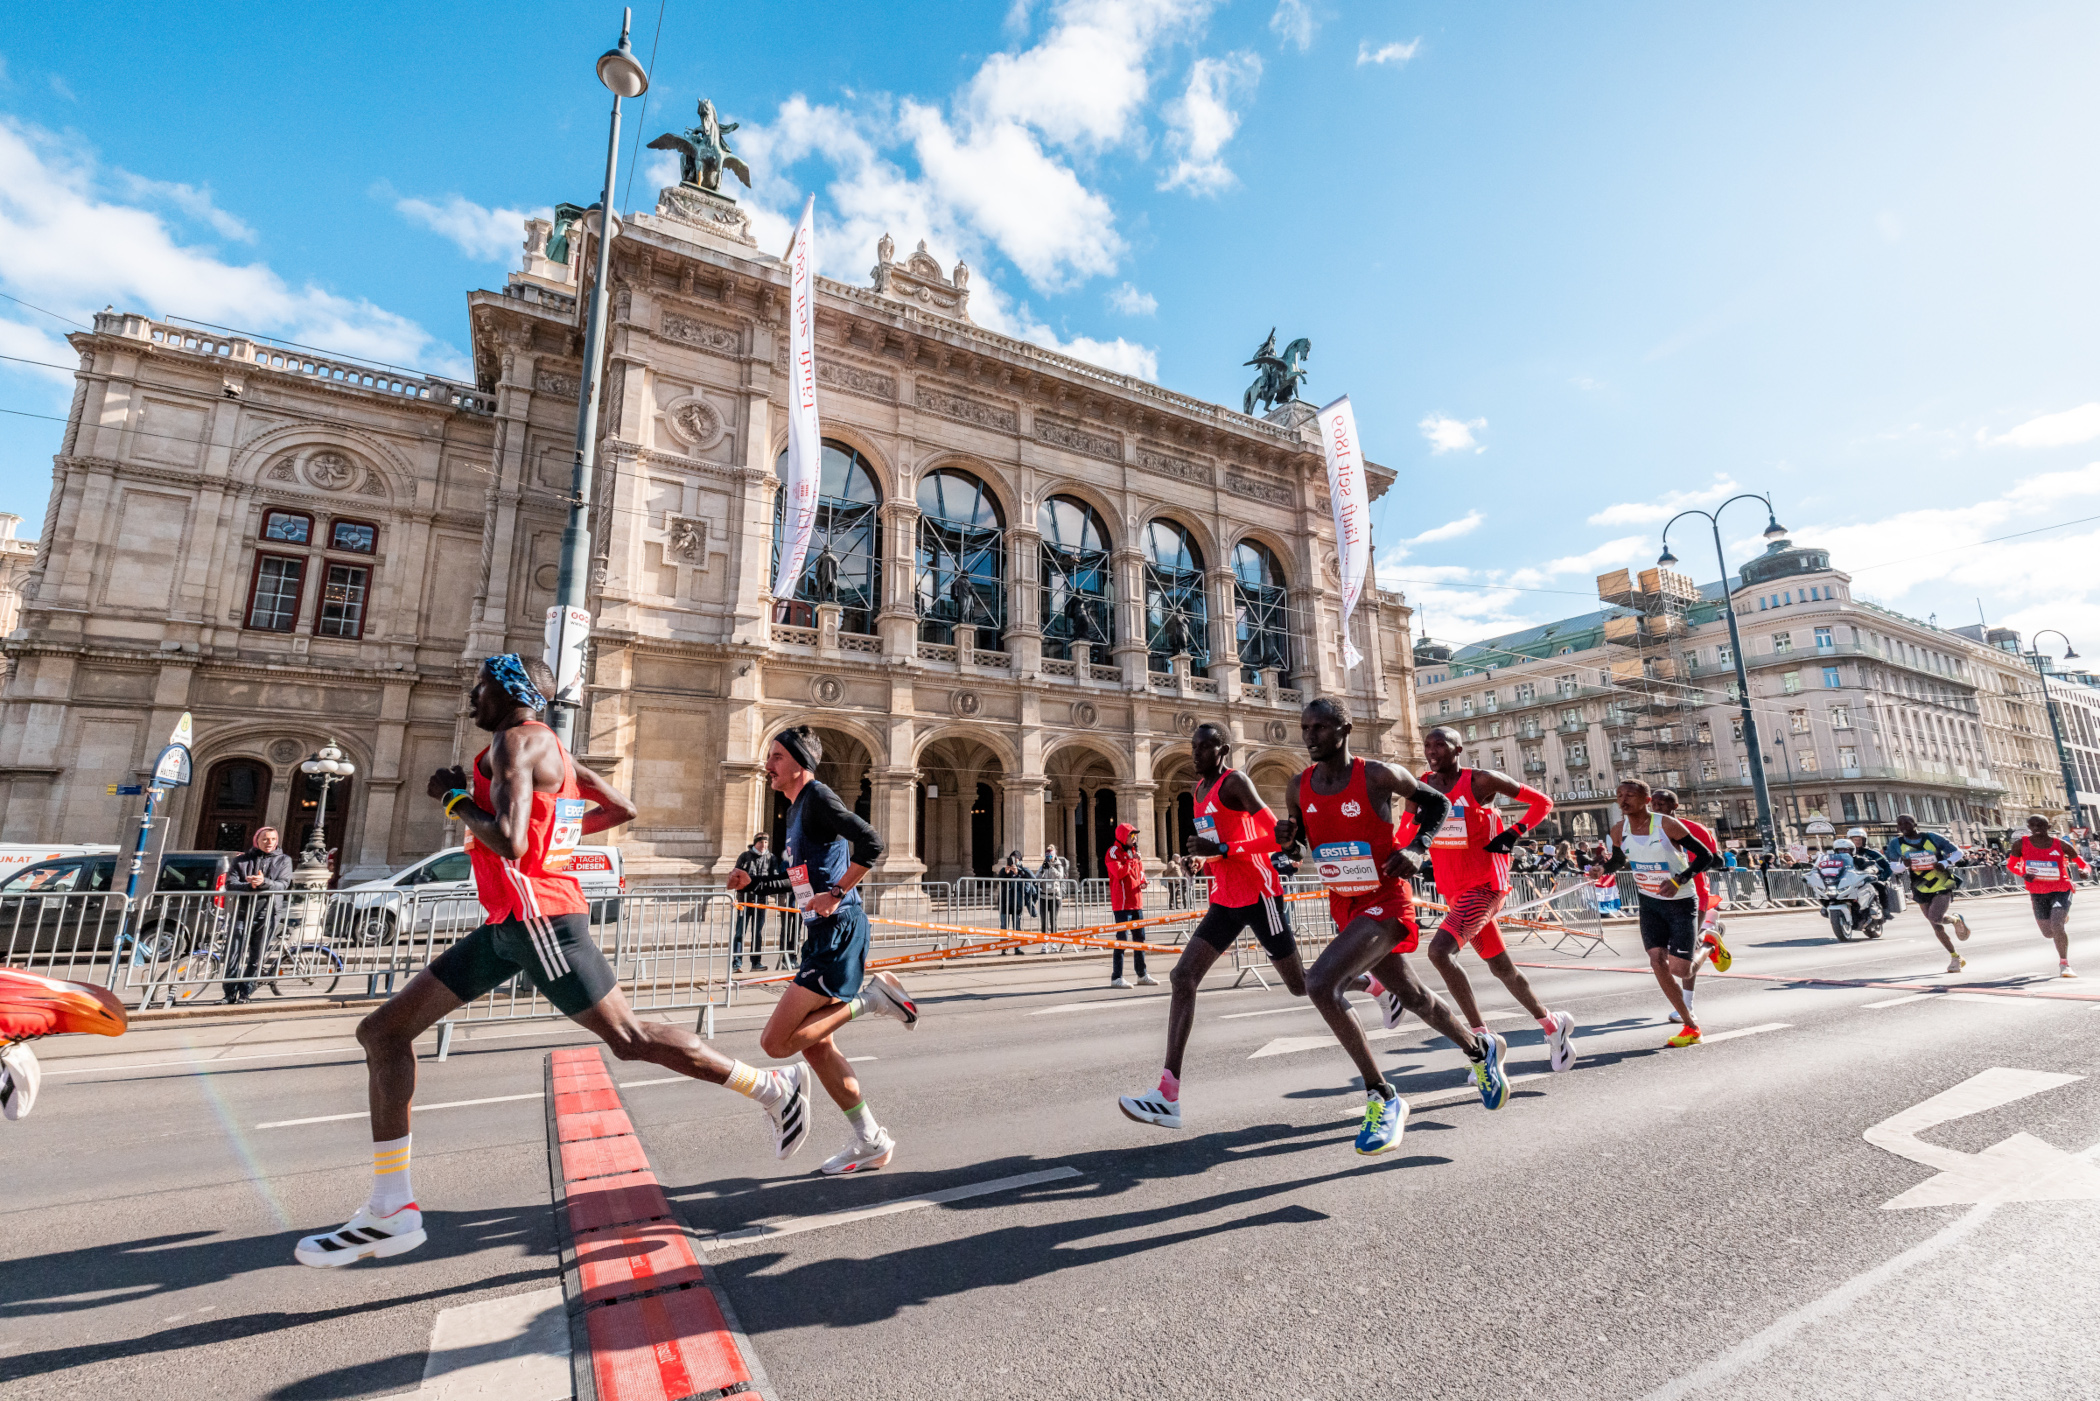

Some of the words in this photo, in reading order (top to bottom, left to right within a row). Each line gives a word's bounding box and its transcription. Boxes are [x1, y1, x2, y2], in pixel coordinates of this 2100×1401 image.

[796, 228, 806, 288] 1869
[796, 289, 808, 337] seit
[799, 349, 814, 410] läuft
[160, 768, 188, 780] HALTESTELLE
[1320, 846, 1349, 857] ERSTE
[1342, 865, 1372, 875] Gedion
